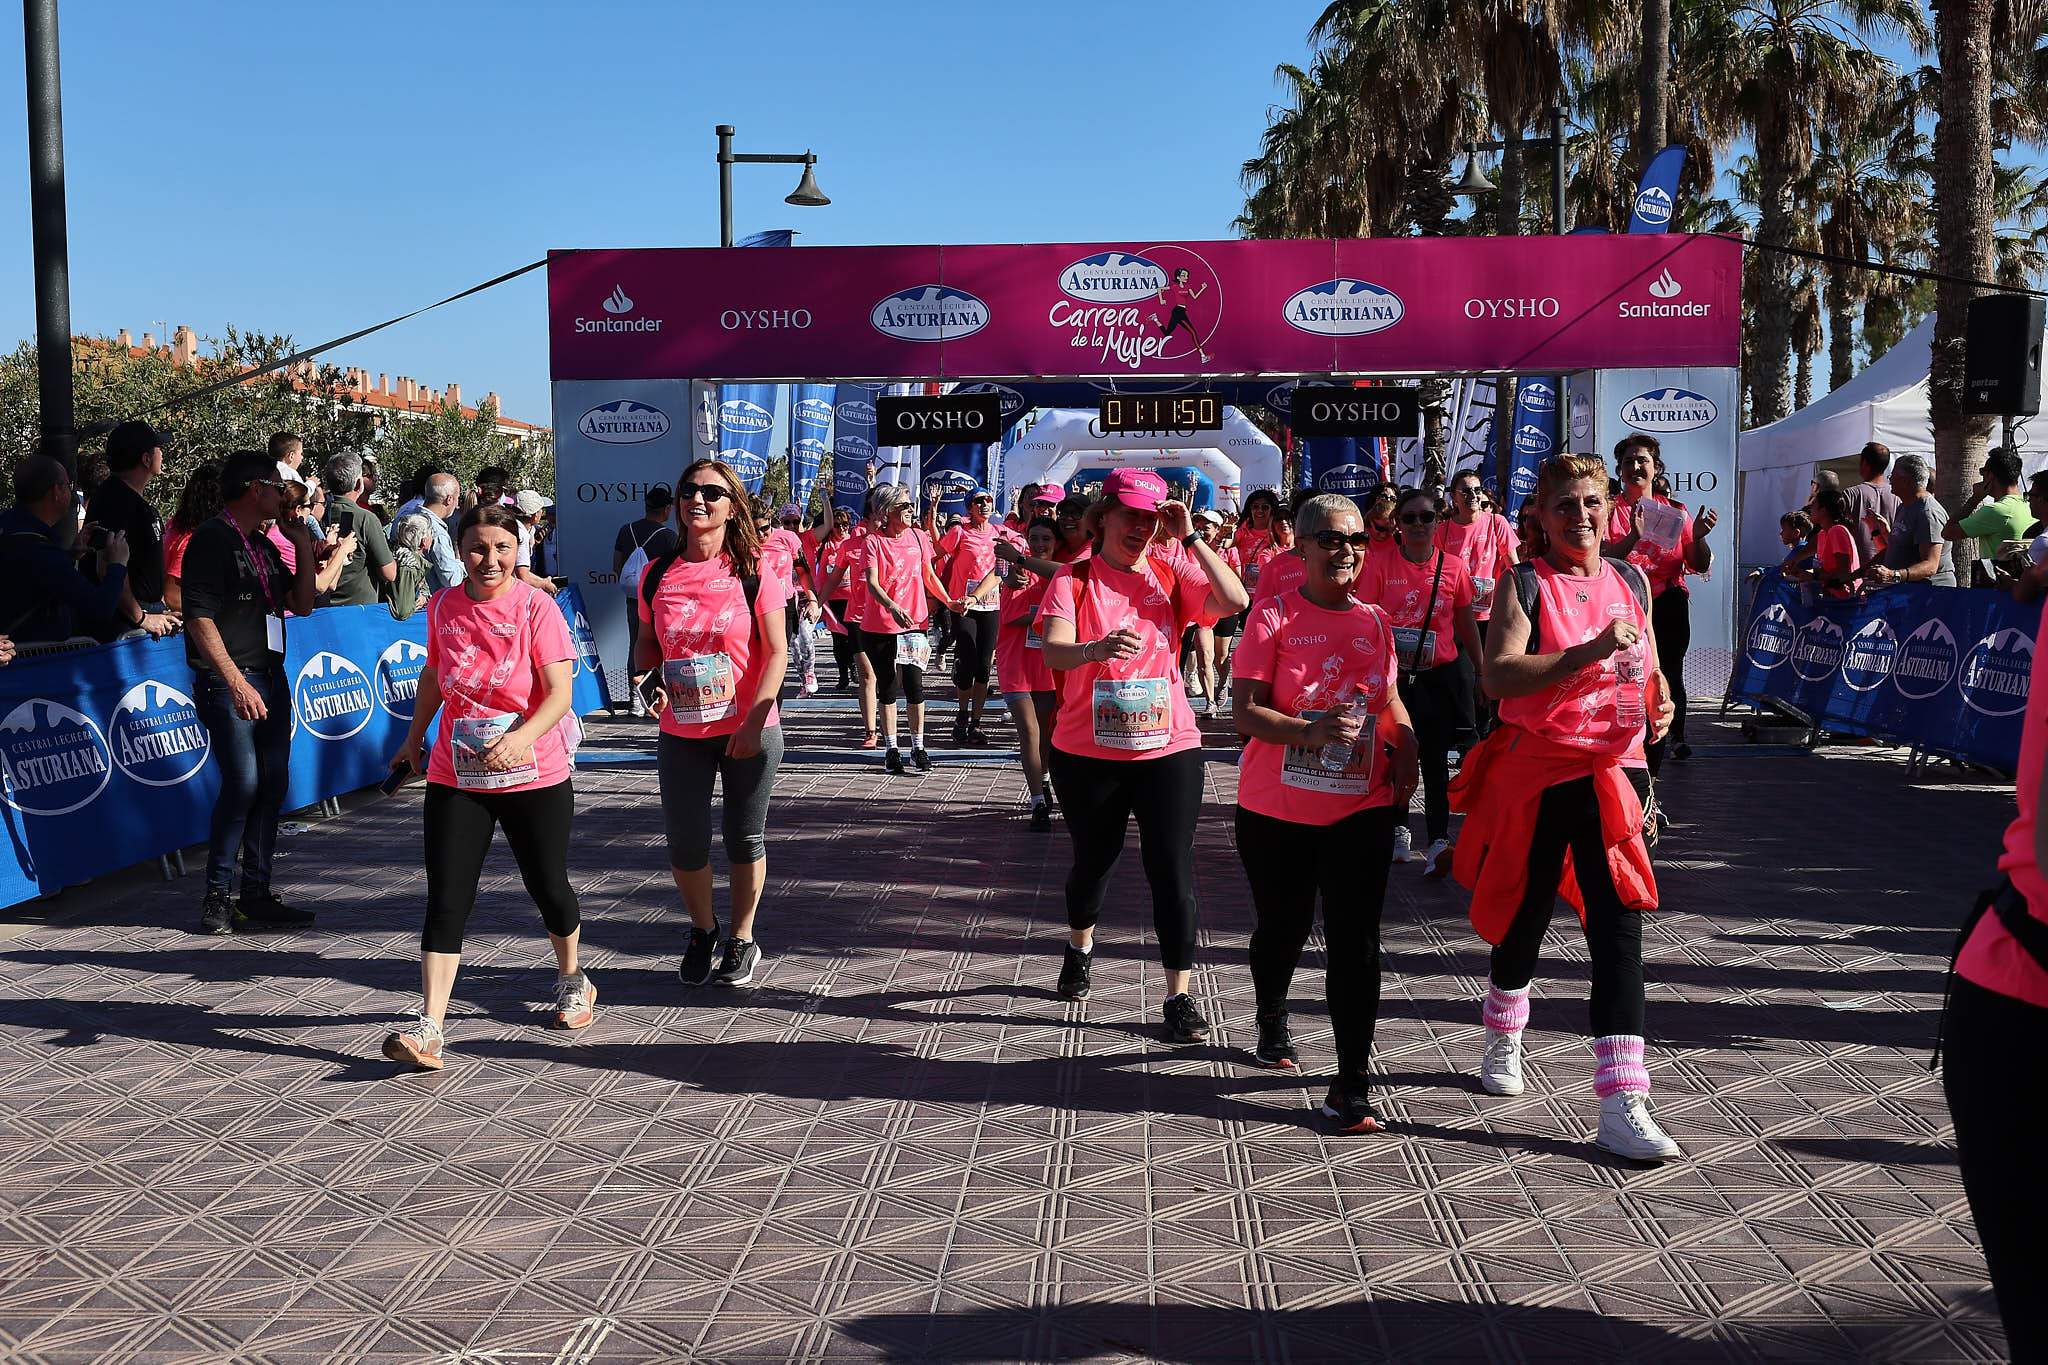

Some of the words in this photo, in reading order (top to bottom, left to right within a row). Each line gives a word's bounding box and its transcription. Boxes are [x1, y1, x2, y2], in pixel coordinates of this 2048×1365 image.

[1067, 271, 1160, 291] ASTURIANA
[880, 306, 981, 327] ASTURIANA
[1049, 300, 1142, 327] Carrera
[1293, 300, 1395, 321] ASTURIANA
[1464, 297, 1560, 319] OYSHO
[1619, 301, 1711, 318] Santander
[575, 317, 663, 333] Santander
[720, 309, 812, 330] OYSHO
[1071, 328, 1088, 347] de
[1091, 330, 1104, 347] la
[1100, 325, 1173, 368] Mujer
[719, 408, 769, 428] ASTURIANA
[897, 410, 984, 430] OYSHO
[1311, 402, 1400, 422] OYSHO
[1628, 404, 1711, 422] ASTURIANA
[585, 417, 664, 433] ASTURIANA
[1023, 442, 1056, 451] OYSHO
[1228, 438, 1262, 446] OYSHO
[1323, 477, 1376, 489] ASTURIANA
[1288, 635, 1327, 646] OYSHO
[389, 667, 414, 678] CENTRAL
[1896, 646, 1950, 681] ASTURIANA
[310, 681, 336, 694] CENTRAL
[336, 676, 362, 688] LECHERA
[1962, 655, 2031, 697] ASTURIAN
[303, 688, 370, 723] ASTURIANA
[130, 716, 162, 731] CENTRAL
[164, 709, 195, 724] LECHERA
[12, 737, 52, 753] CENTRAL
[54, 730, 93, 746] LECHERA
[120, 723, 206, 766] ASTURIANA
[0, 746, 107, 792] ASTURIANA
